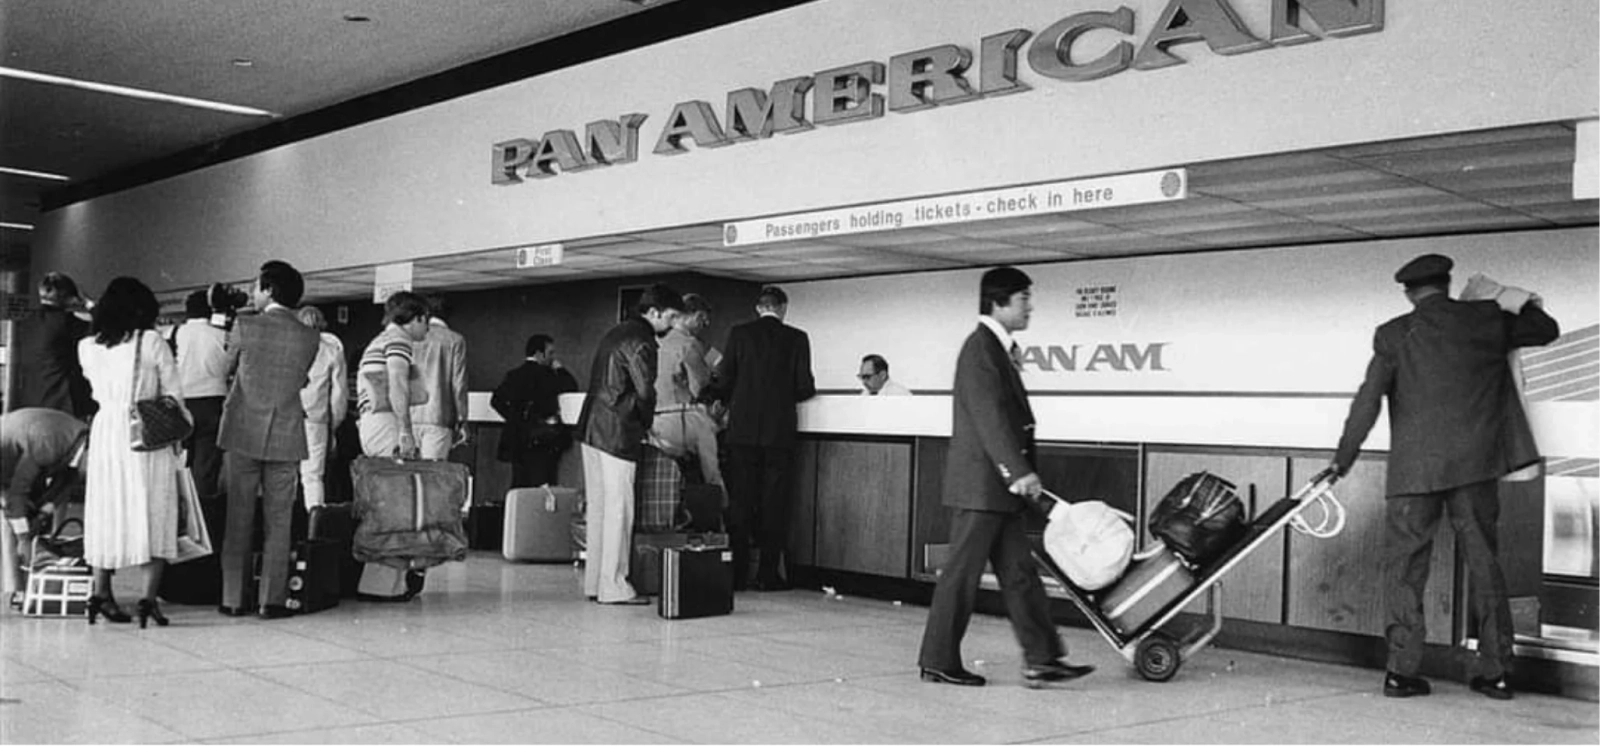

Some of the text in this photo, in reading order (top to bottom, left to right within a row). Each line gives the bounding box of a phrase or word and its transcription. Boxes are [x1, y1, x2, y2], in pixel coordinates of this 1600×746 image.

[491, 113, 648, 185] PAN
[765, 217, 840, 238] Passengers
[850, 210, 903, 228] holding
[914, 202, 971, 221] tickets
[986, 192, 1038, 214] check
[1048, 189, 1063, 207] in
[1073, 186, 1114, 204] here
[1085, 342, 1173, 371] AM
